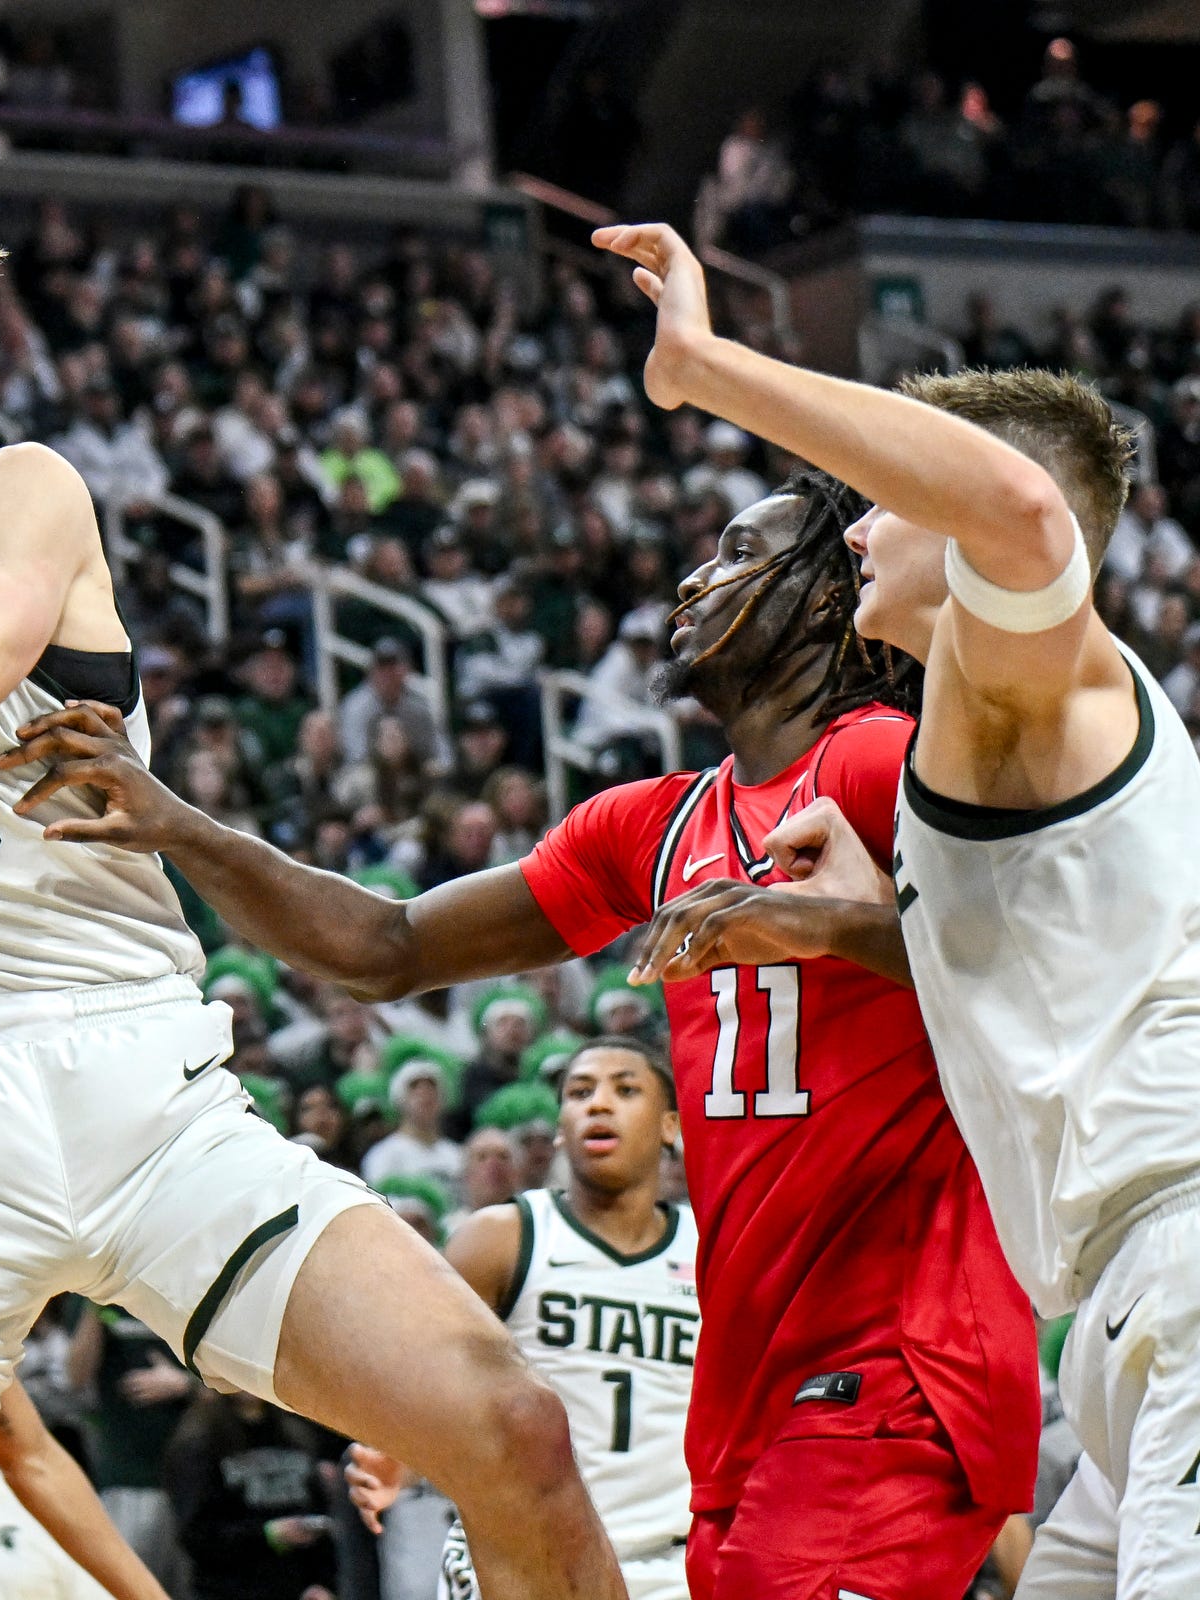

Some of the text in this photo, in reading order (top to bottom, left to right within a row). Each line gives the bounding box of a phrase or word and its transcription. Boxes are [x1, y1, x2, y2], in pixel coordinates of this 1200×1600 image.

[703, 963, 812, 1119] 11
[538, 1290, 701, 1367] STATE
[602, 1368, 632, 1453] 1
[836, 1379, 846, 1393] L
